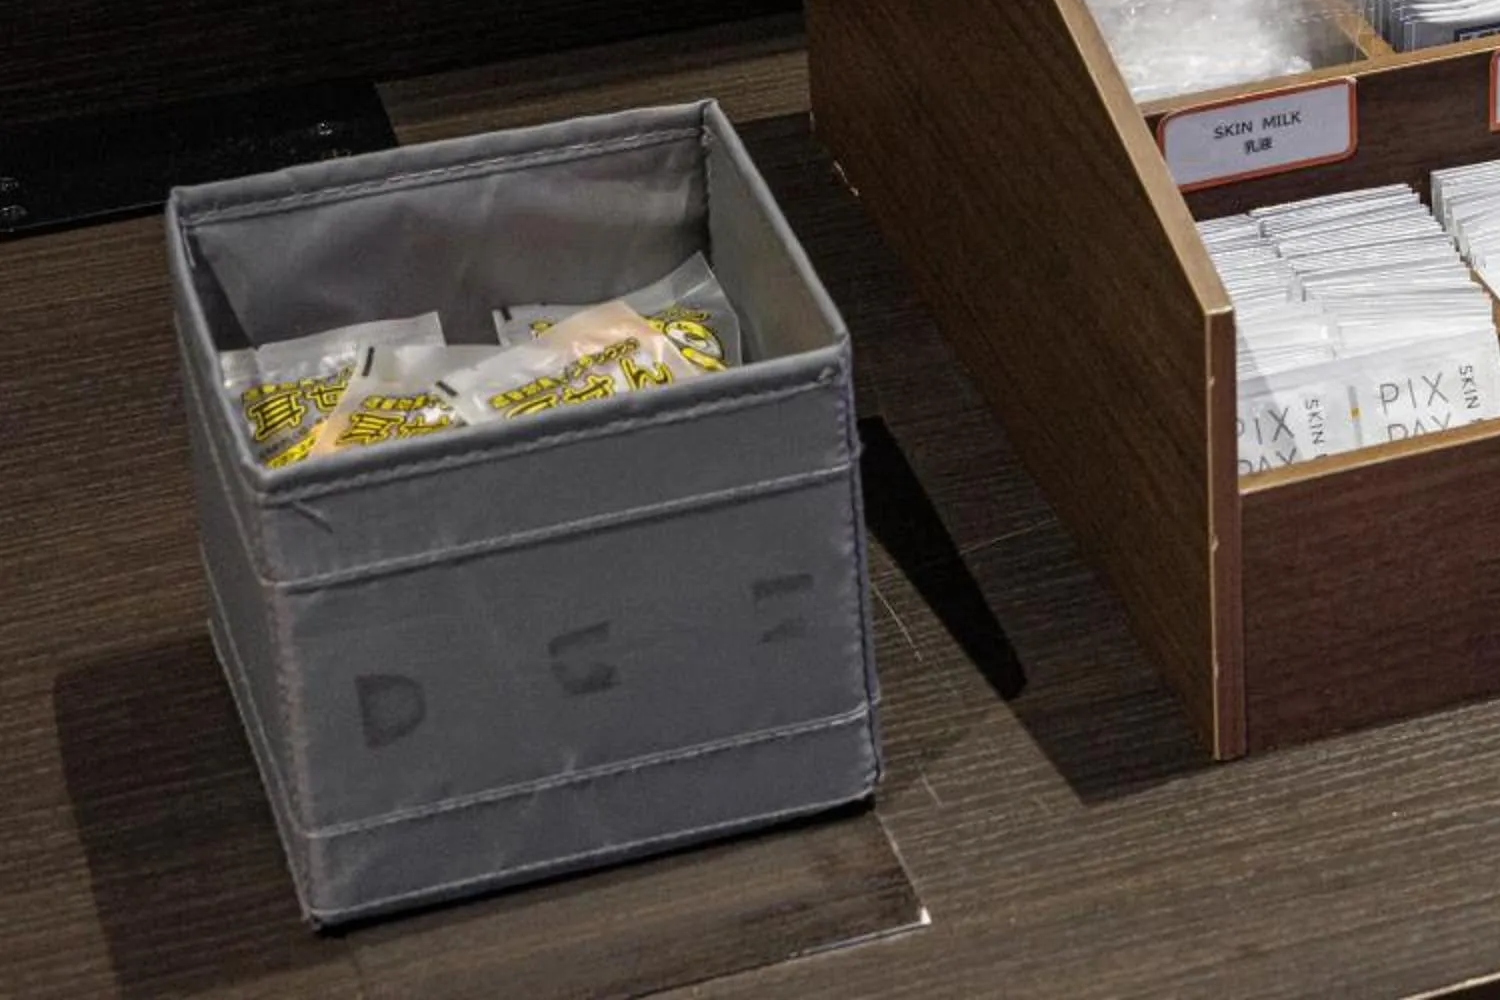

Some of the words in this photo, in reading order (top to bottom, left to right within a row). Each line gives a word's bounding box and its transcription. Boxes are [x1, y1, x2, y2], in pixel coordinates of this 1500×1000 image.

[1213, 120, 1253, 139] SKIN
[1262, 112, 1302, 129] MILK
[1243, 137, 1273, 155] 乳液
[1379, 372, 1449, 416] PIX
[1459, 365, 1480, 409] SKIN
[1305, 398, 1327, 446] SKIN
